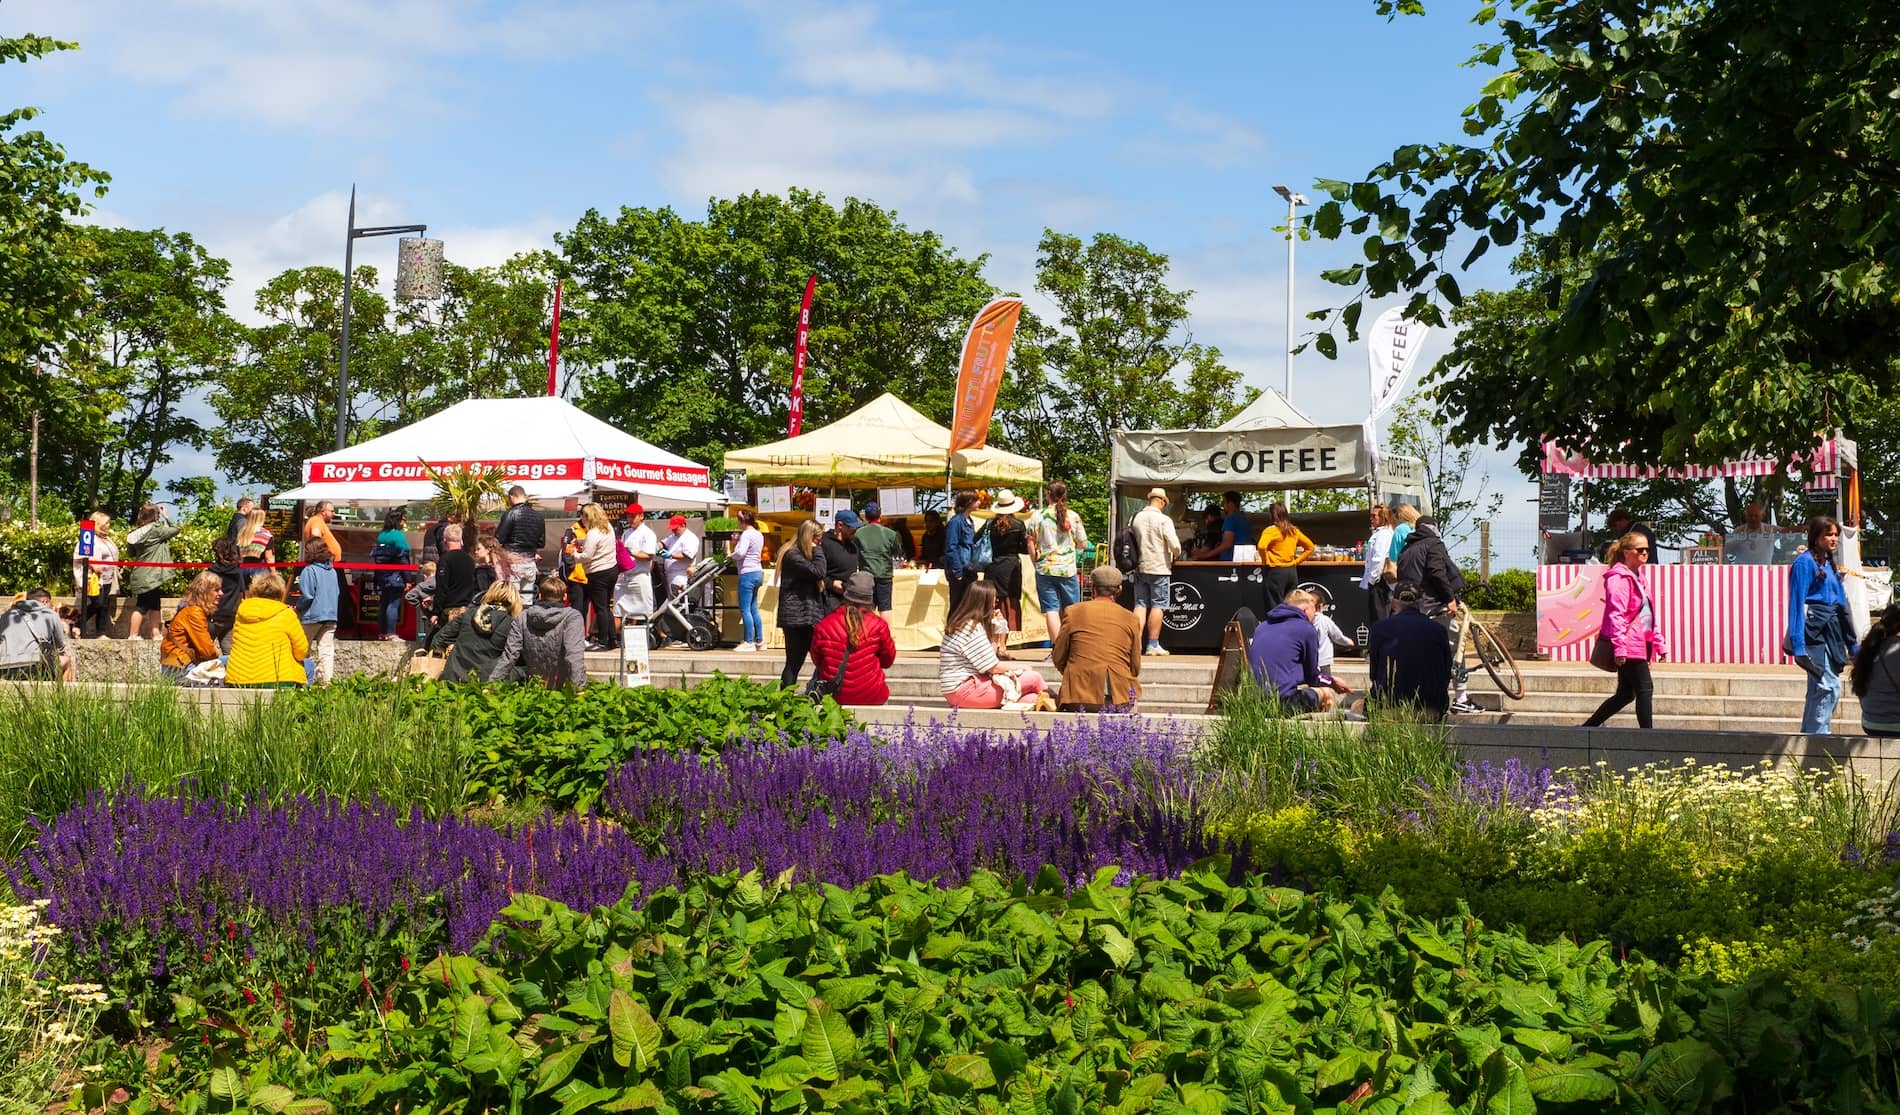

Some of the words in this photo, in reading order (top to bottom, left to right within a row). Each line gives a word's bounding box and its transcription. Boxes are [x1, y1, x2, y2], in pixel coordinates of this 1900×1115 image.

[1382, 324, 1408, 398] COFFEE
[323, 464, 372, 482] Roy's
[469, 461, 568, 479] Sasages
[768, 454, 810, 467] TUTTI
[1209, 447, 1337, 474] COFFEE
[1388, 456, 1410, 478] COFFEE
[596, 462, 622, 478] Roy's
[624, 464, 665, 481] Gourmet
[666, 468, 707, 486] Sausages
[83, 530, 92, 545] Q
